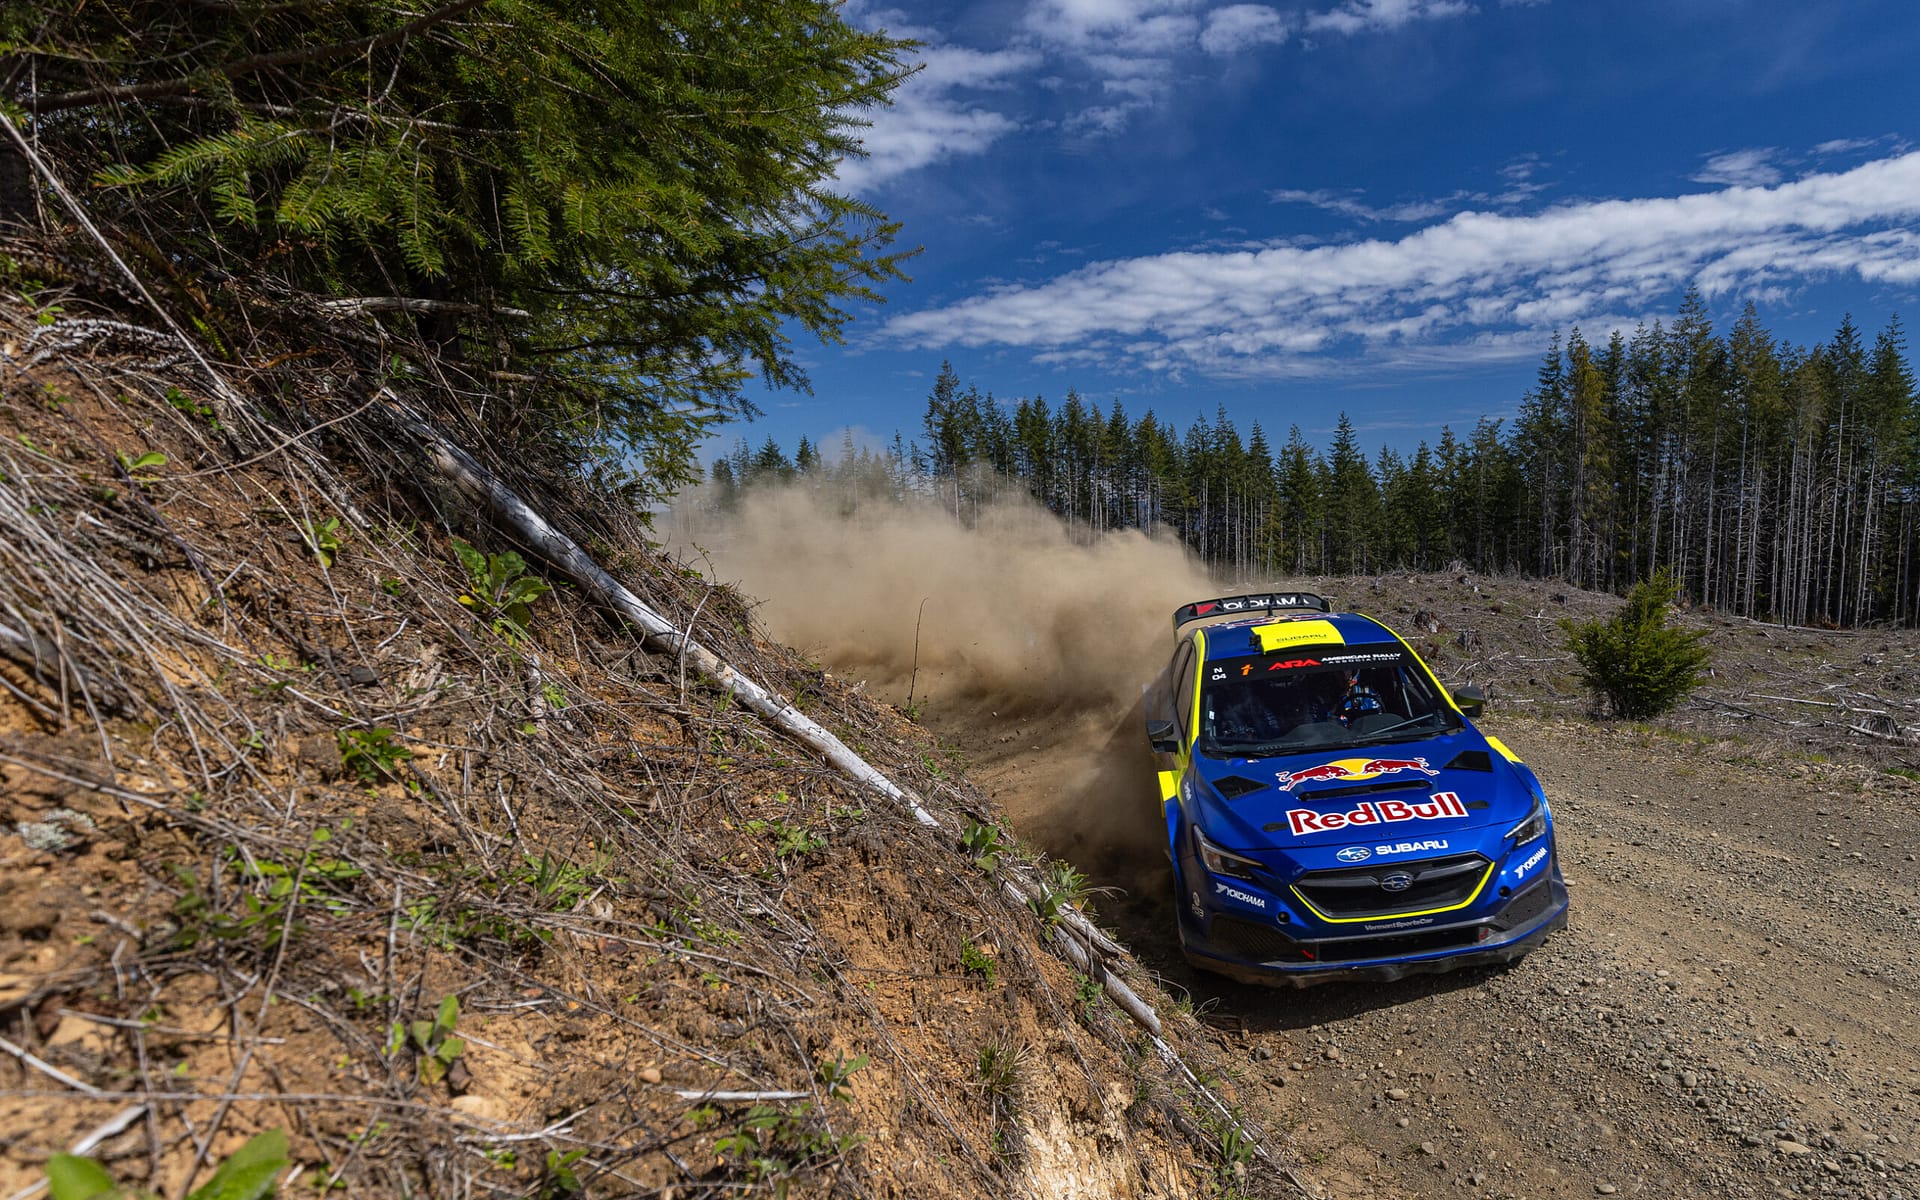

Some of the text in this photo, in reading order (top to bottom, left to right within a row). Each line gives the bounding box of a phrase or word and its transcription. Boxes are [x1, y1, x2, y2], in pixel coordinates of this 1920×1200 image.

[1267, 658, 1322, 671] ARA
[1211, 673, 1227, 681] 04
[1287, 792, 1469, 836] Red Bull
[1375, 840, 1449, 856] SUBARU
[1215, 882, 1266, 909] YOKOHAMA
[1364, 918, 1435, 931] VermontSportsCar
